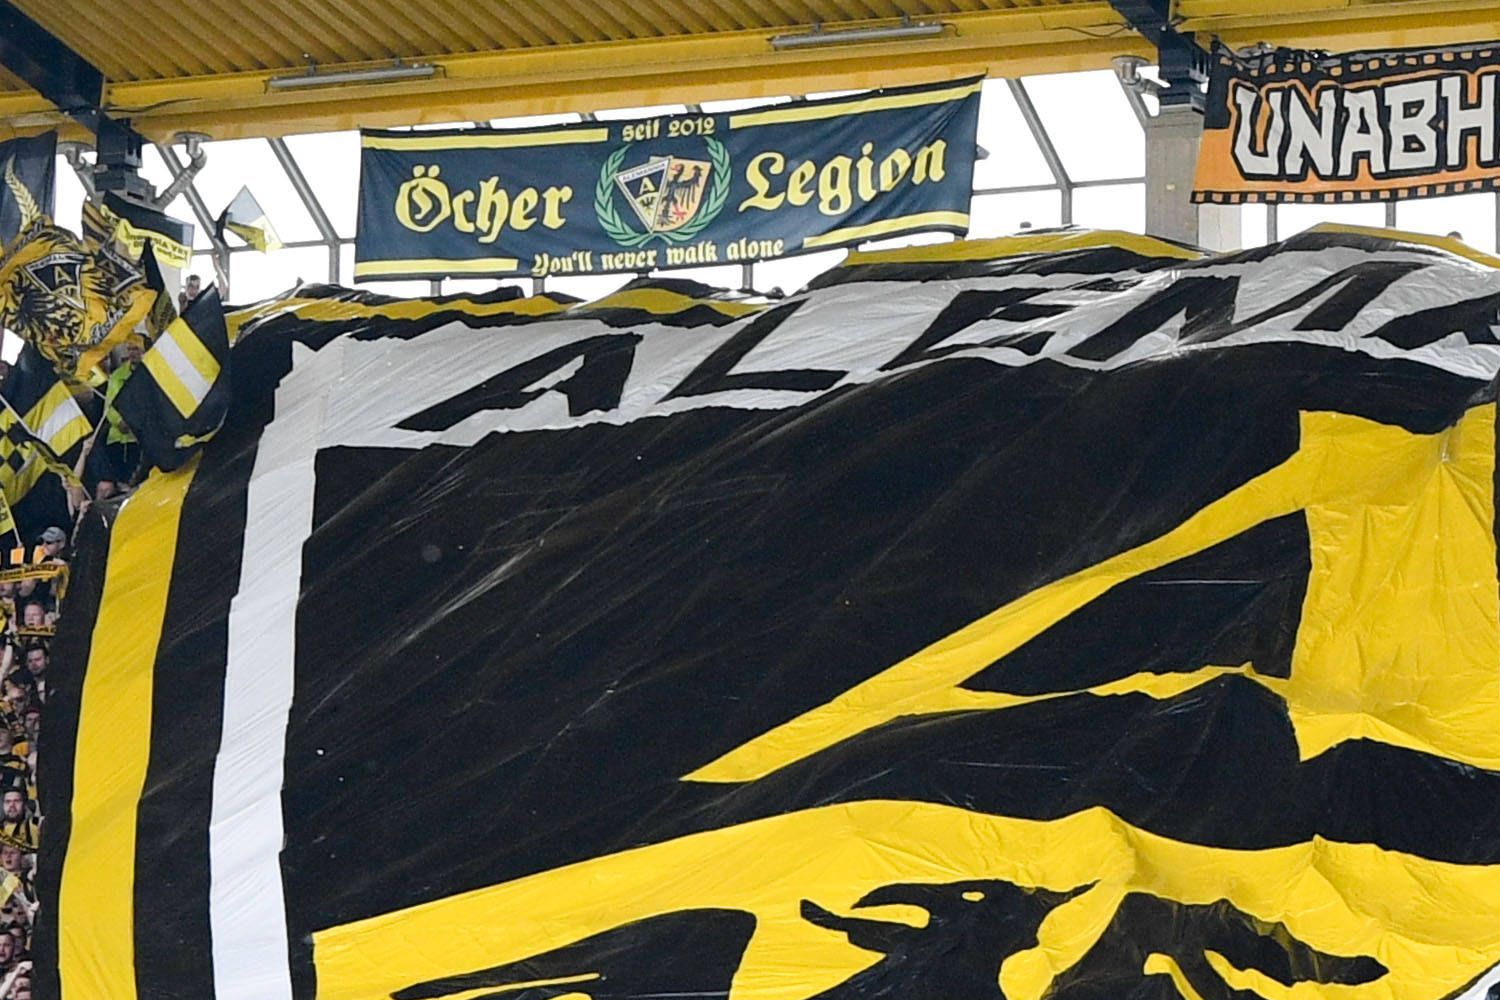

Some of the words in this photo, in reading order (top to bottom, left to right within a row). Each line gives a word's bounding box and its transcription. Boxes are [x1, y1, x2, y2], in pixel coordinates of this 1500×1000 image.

[667, 116, 715, 138] 2012
[394, 164, 573, 242] Öcher
[738, 138, 946, 215] Legion
[602, 247, 657, 270] never
[666, 240, 718, 265] walk
[726, 237, 784, 260] alone
